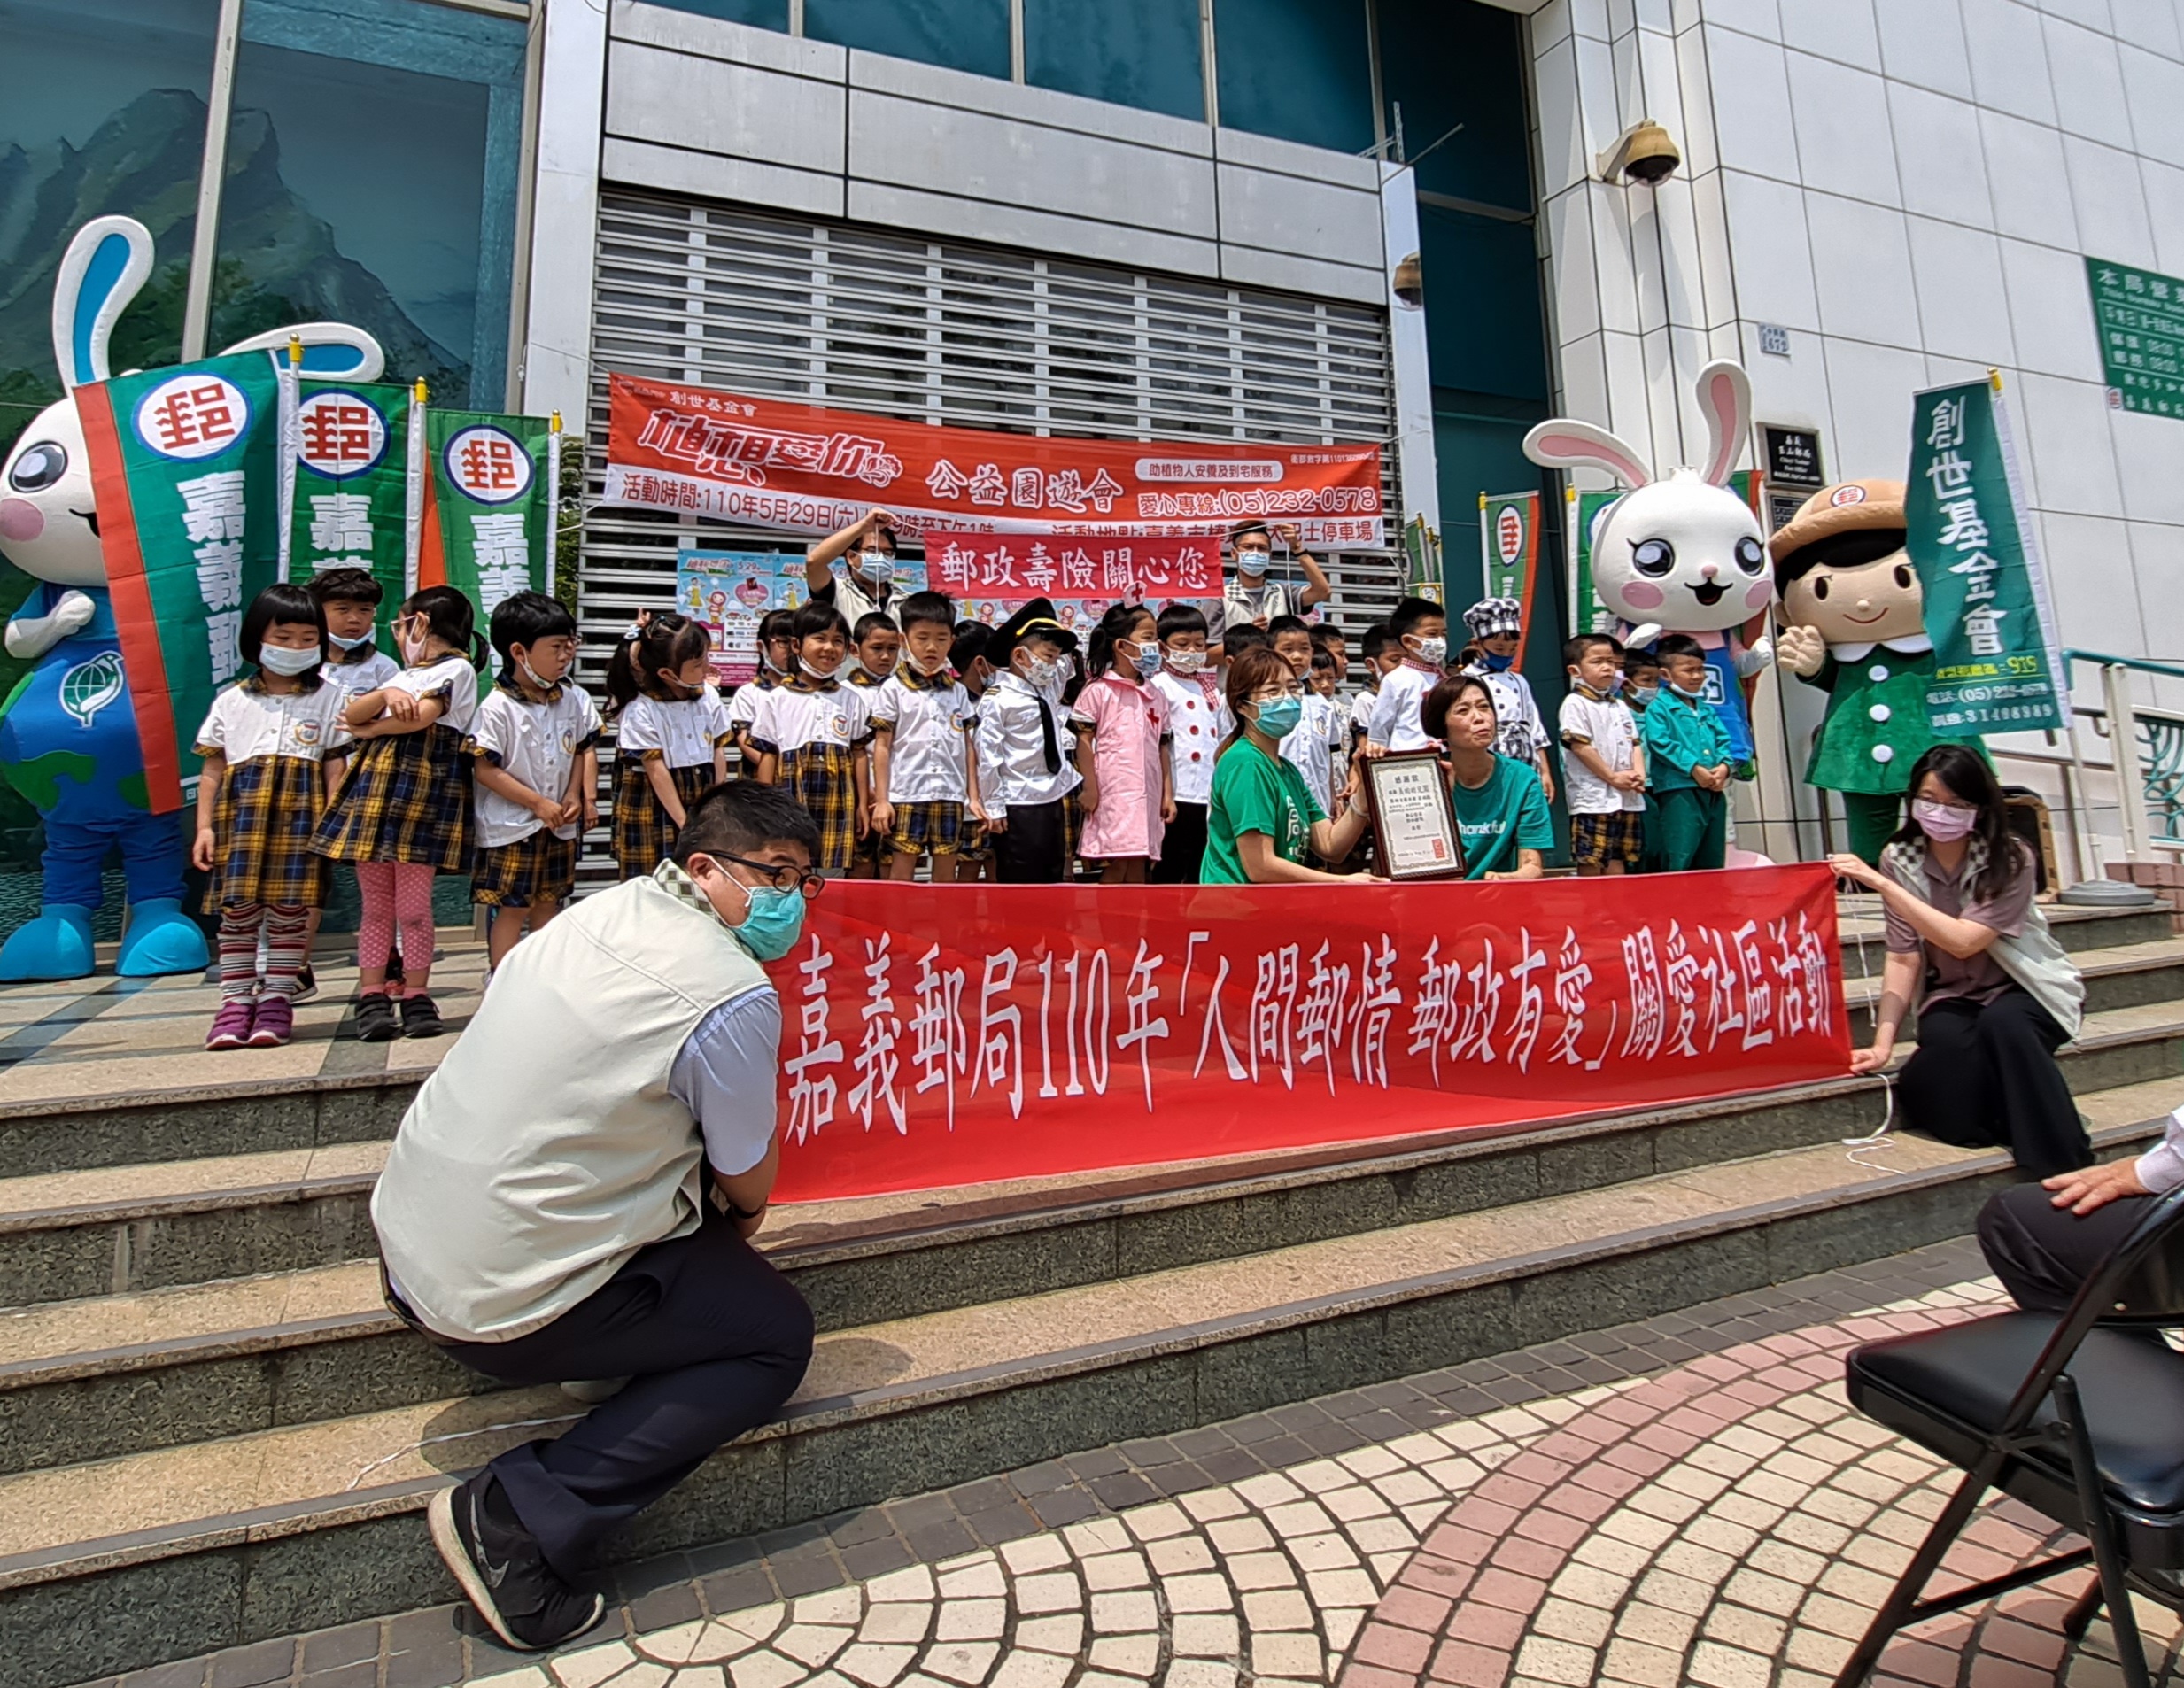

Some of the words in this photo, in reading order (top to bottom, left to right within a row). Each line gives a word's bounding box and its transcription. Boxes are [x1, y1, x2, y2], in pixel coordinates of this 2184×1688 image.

[153, 383, 236, 450] 郵
[670, 391, 756, 417] 創世基金會
[302, 404, 371, 461] 郵
[461, 439, 517, 489] 郵
[925, 459, 1124, 514] 公益園遊會
[1149, 463, 1274, 478] 助植物人安養及到宅服務
[1138, 486, 1377, 517] 愛心專線:(05)232-0578
[1925, 395, 2009, 655] 創世基金會
[175, 470, 246, 695] 嘉義郵
[939, 540, 1209, 592] 郵政壽險關心您
[1457, 819, 1506, 835] hankful
